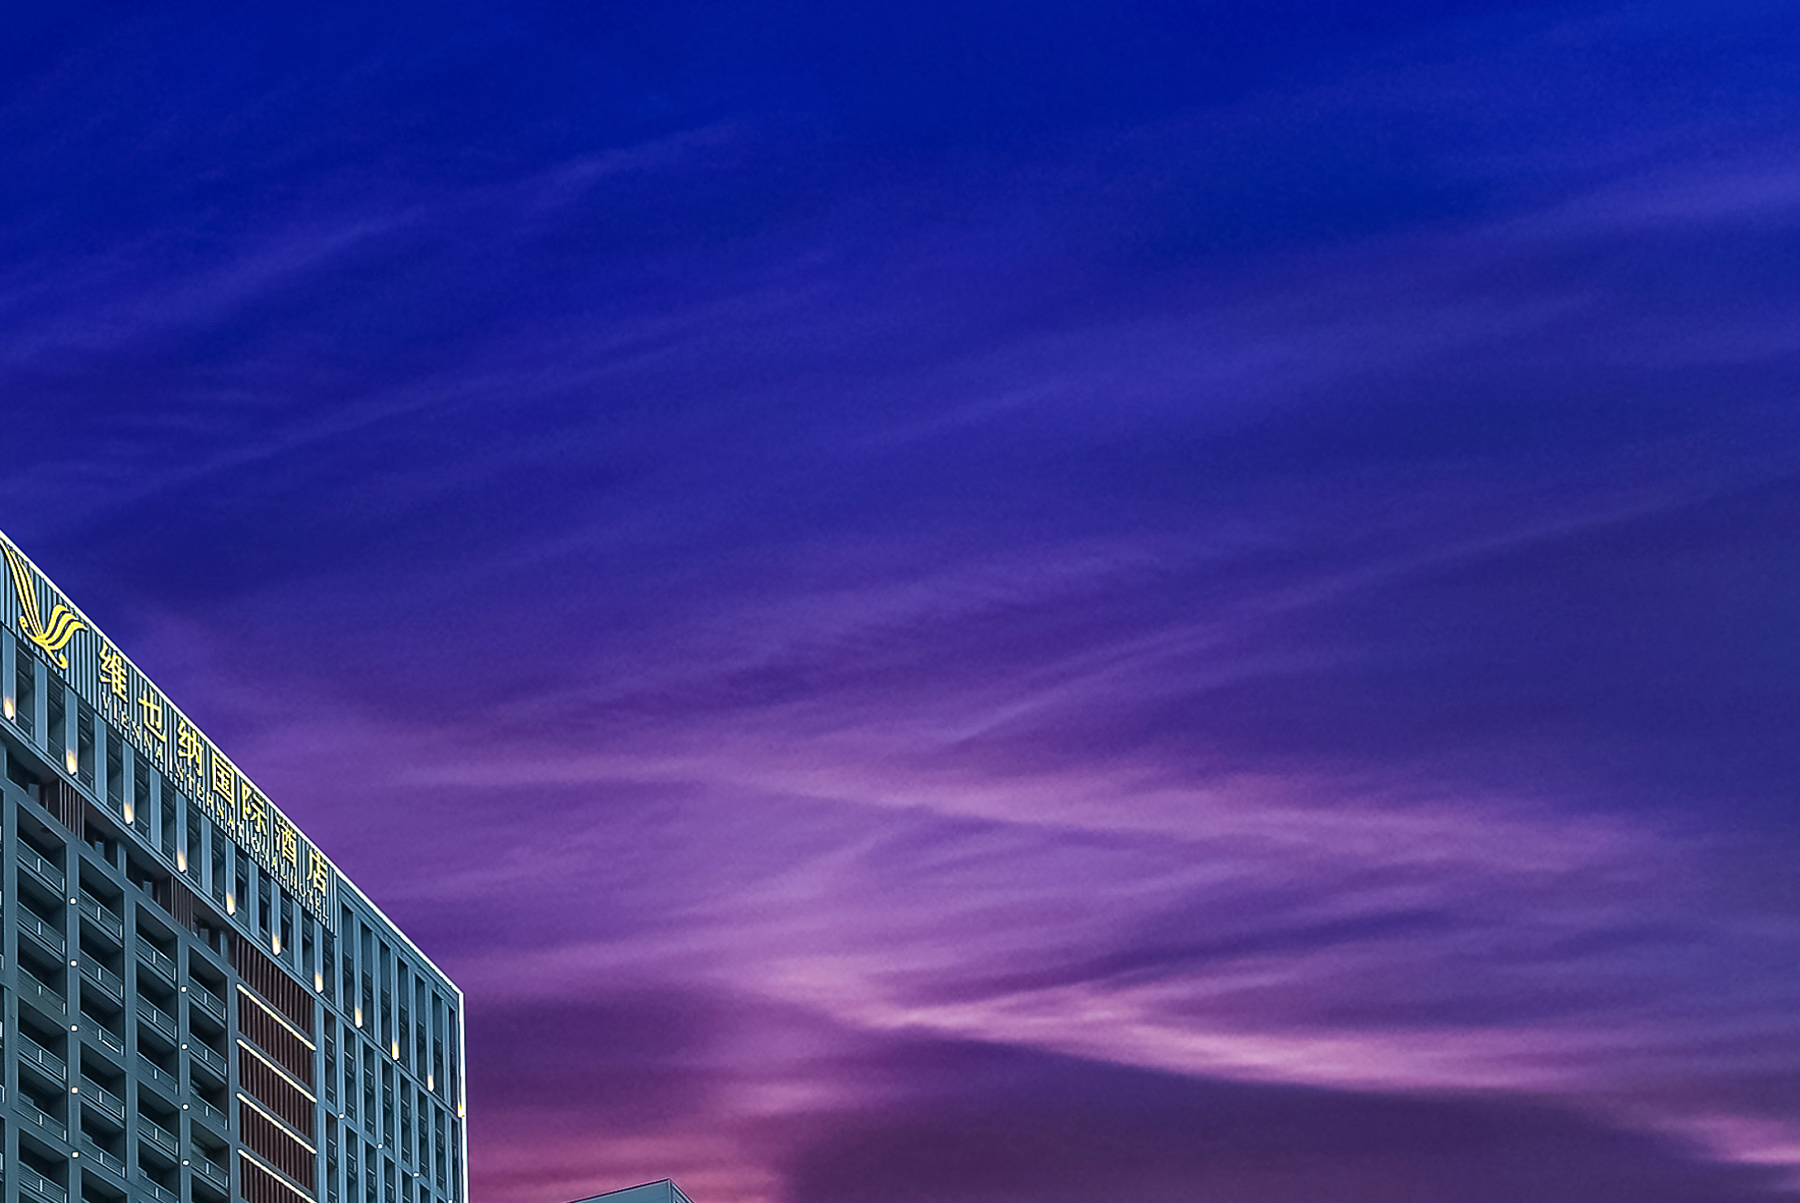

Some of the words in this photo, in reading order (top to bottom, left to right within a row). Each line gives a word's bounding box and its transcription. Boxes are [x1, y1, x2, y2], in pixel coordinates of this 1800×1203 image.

[98, 640, 328, 898] 维也纳国际酒店
[101, 691, 164, 765] VIENNA
[167, 755, 287, 880] INTERNATIONAL
